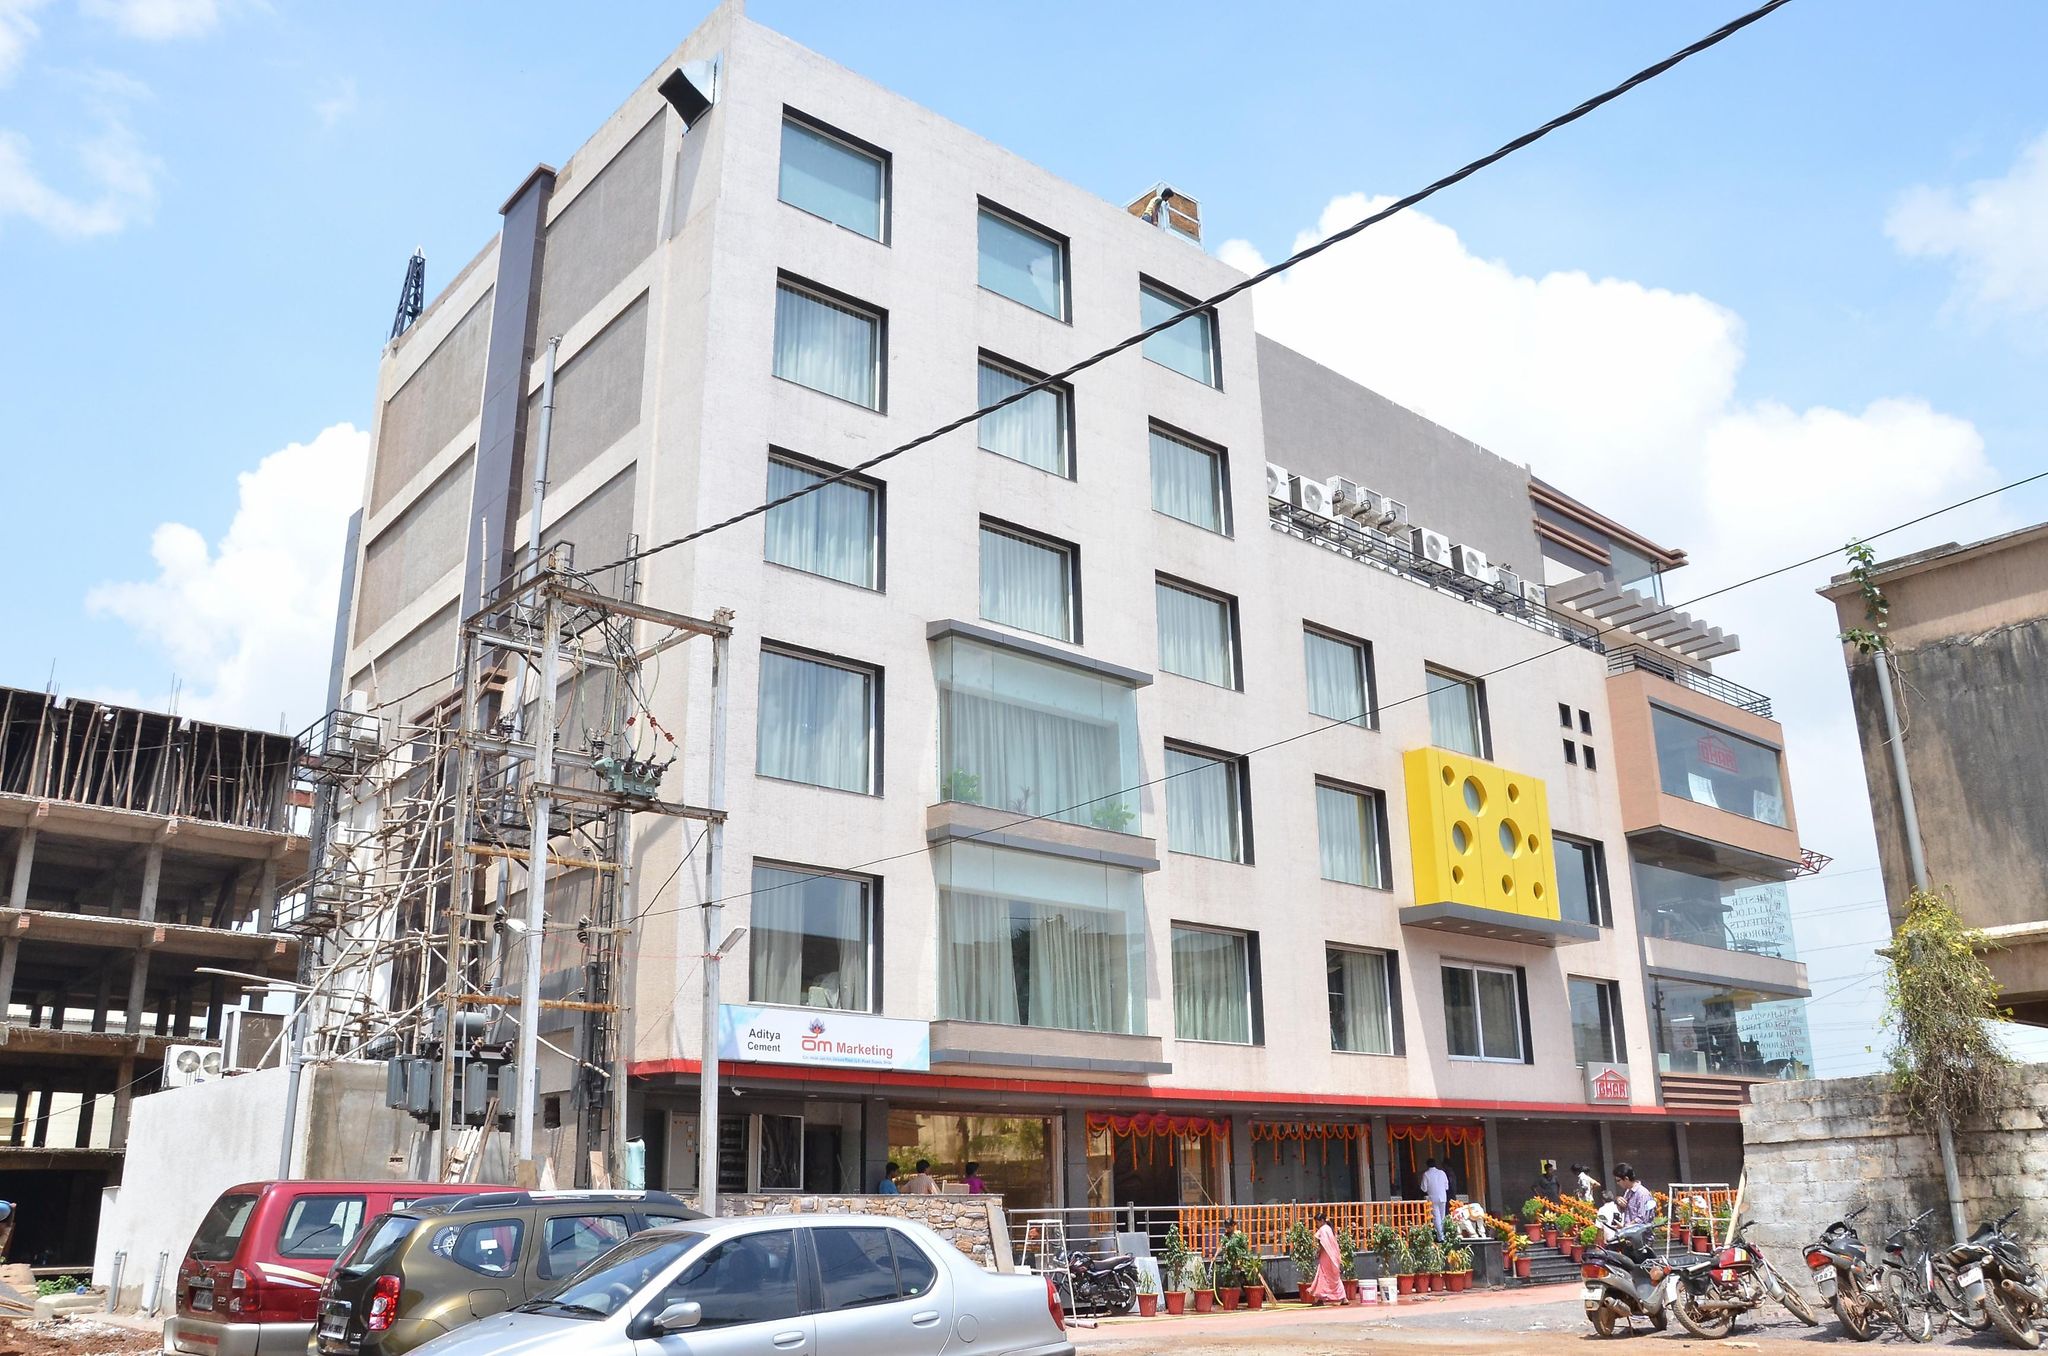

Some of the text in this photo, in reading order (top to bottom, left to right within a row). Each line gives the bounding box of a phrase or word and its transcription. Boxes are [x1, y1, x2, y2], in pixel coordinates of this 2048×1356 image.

[748, 1028, 781, 1041] Aditya
[747, 1041, 781, 1053] Cement
[836, 1042, 893, 1059] Marketing
[1597, 1081, 1628, 1098] GHAR
